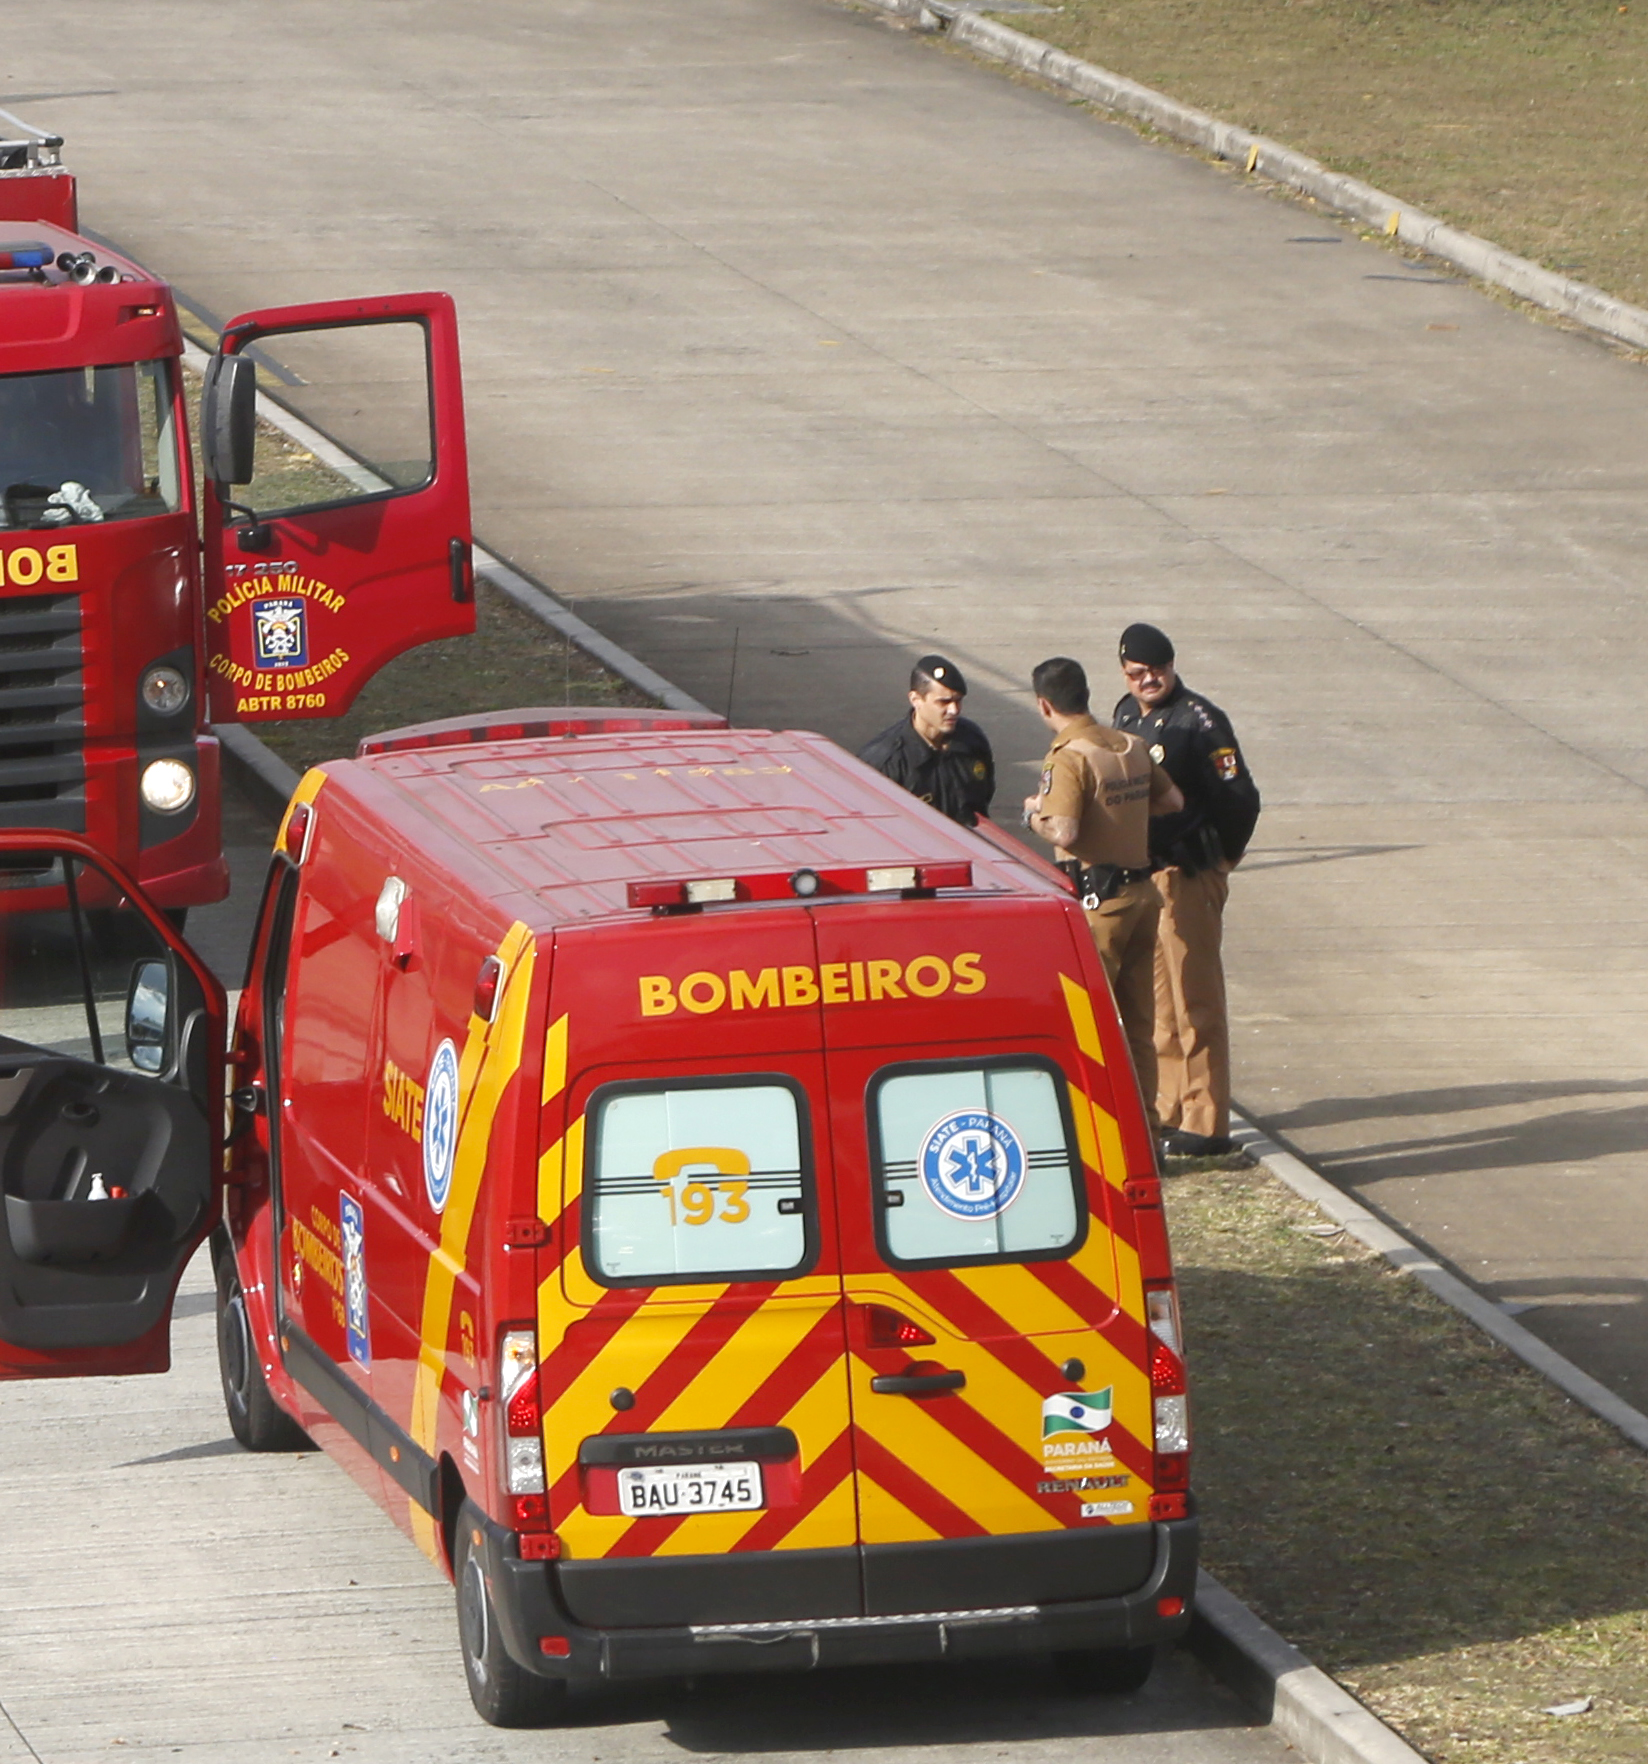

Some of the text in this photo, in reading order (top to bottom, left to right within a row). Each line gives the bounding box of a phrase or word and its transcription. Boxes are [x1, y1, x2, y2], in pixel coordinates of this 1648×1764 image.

[207, 574, 346, 624] POLÍCIA MILITAR
[209, 648, 350, 692] CORPO DE BOMBEIROS
[237, 693, 326, 713] ABTR 8760
[639, 952, 987, 1017] BOMBEIROS
[382, 1059, 425, 1144] SIATE
[929, 1120, 960, 1154] SIATE
[311, 1204, 332, 1242] CORPO
[660, 1180, 751, 1226] 193
[292, 1217, 345, 1296] BOMBEIROS
[634, 1444, 745, 1458] MASTER
[1043, 1437, 1113, 1457] PARANÁ
[1037, 1475, 1131, 1494] RENAULT
